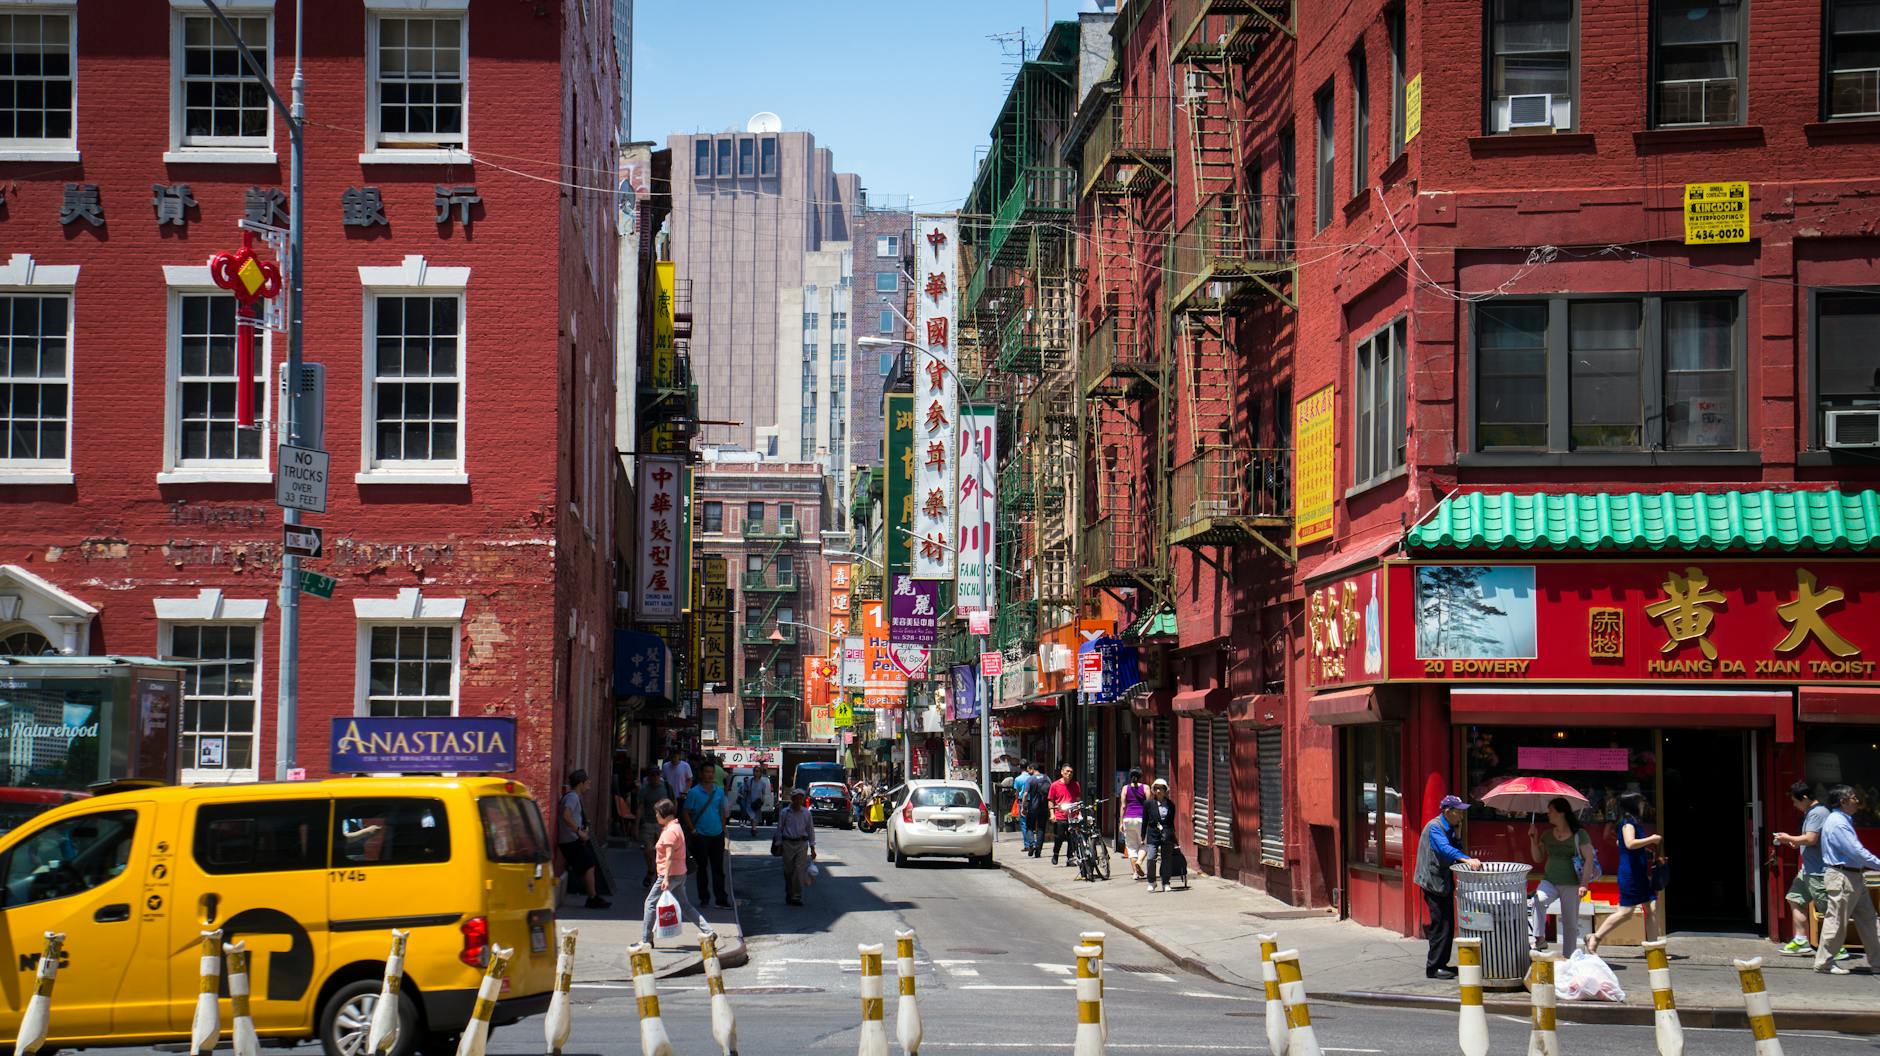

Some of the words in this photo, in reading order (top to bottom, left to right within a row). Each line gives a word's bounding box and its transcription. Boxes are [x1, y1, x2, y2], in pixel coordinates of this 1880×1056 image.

[1695, 202, 1739, 213] KINGDOM
[1695, 228, 1745, 240] 434-0020
[295, 452, 313, 466] NO
[284, 465, 323, 483] TRUCKS
[292, 482, 313, 493] OVER
[959, 425, 994, 558] 川外川
[285, 492, 295, 502] 33
[300, 494, 318, 505] FEET
[646, 466, 673, 592] 中華髮型屋
[288, 533, 301, 546] ONE
[304, 535, 317, 548] WAY
[318, 577, 333, 590] ST
[1644, 567, 1862, 661] 黃大
[707, 587, 725, 679] 錦江飯店
[1593, 612, 1620, 653] 赤松
[1424, 660, 1445, 673] 20
[1452, 660, 1530, 673] BOWERY
[1647, 660, 1713, 674] HUANG
[1720, 660, 1746, 674] DA
[1755, 660, 1800, 674] XIAN
[1808, 660, 1876, 675] TAOIST
[876, 697, 896, 705] PELL
[11, 722, 100, 738] Naturehood
